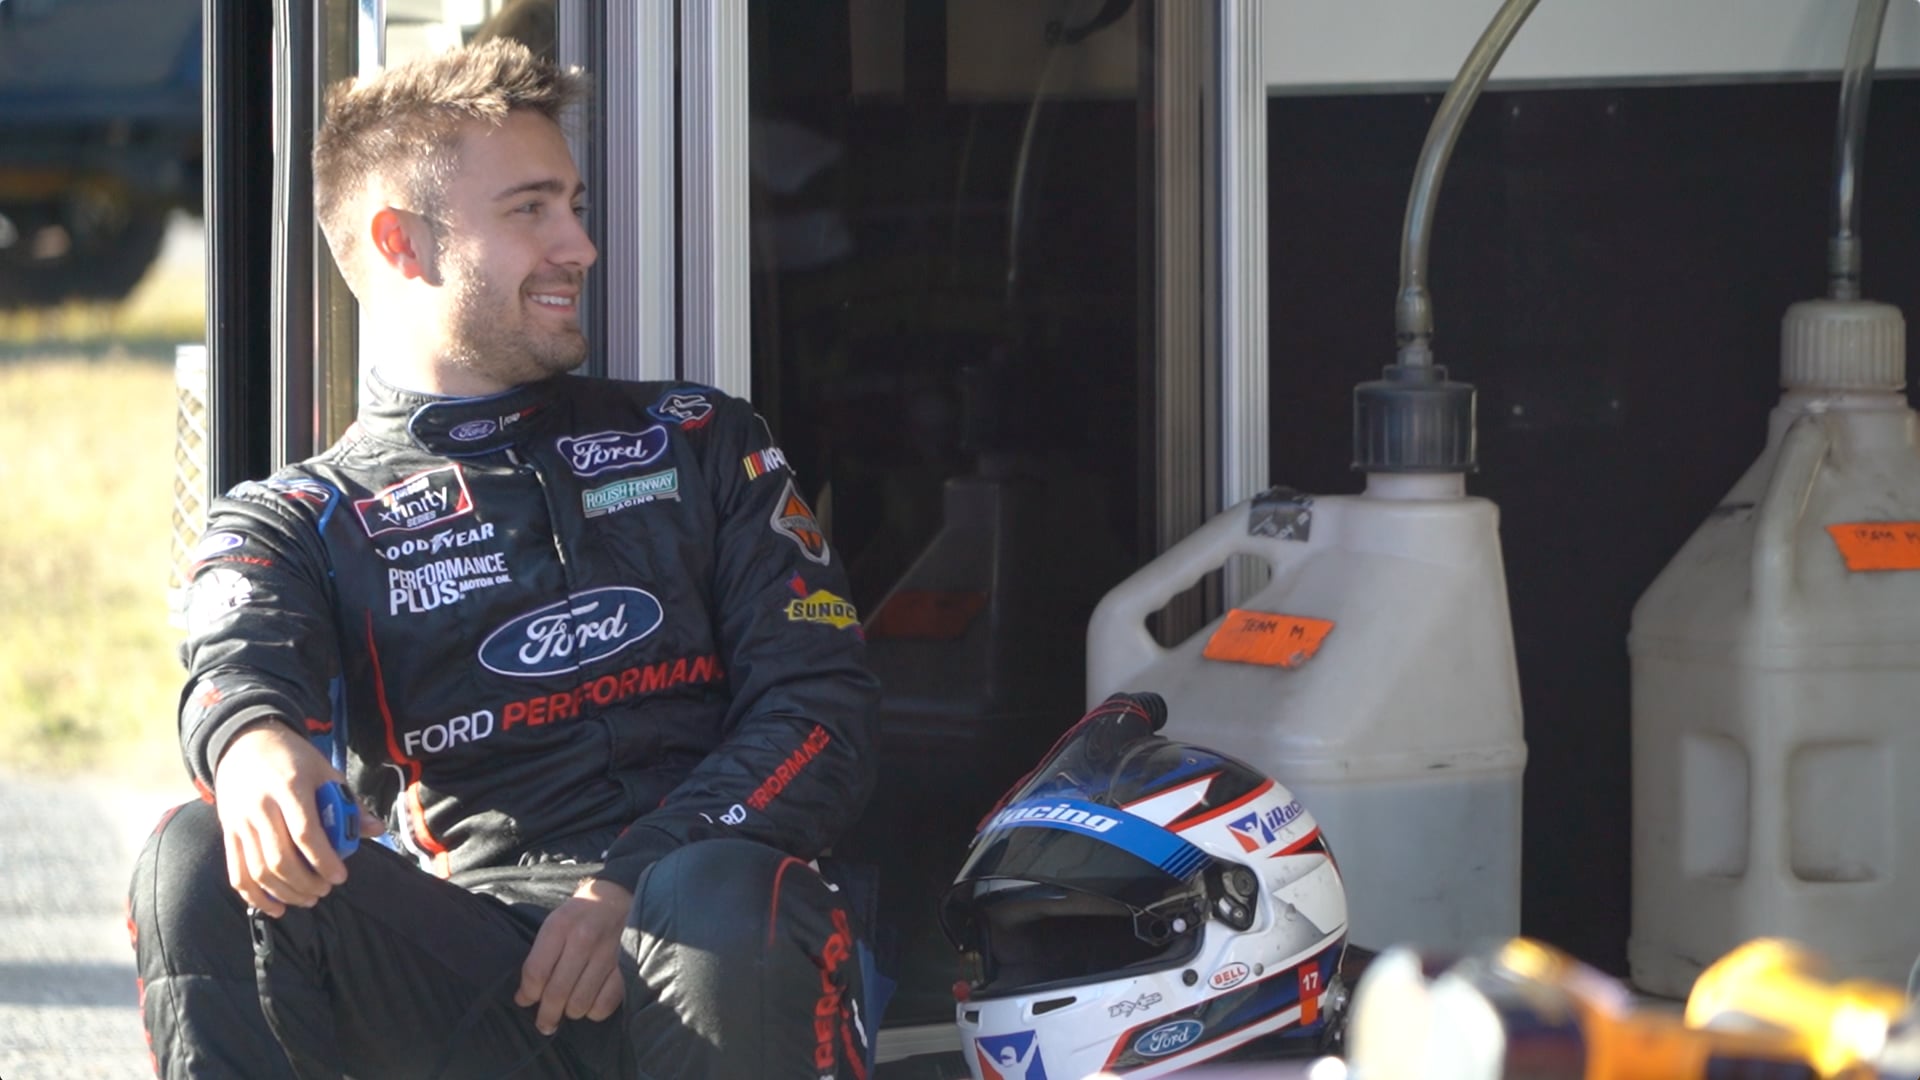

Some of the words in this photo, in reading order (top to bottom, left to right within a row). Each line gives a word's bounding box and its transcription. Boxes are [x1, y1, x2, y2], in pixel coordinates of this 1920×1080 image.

[458, 422, 490, 438] Ford
[573, 435, 648, 470] Ford
[378, 486, 448, 526] xfinity
[586, 481, 628, 509] ROUSH
[628, 472, 674, 497] FENWAY
[607, 494, 655, 514] RACING
[406, 510, 437, 528] SERIES
[380, 522, 495, 561] OODYEAR
[388, 552, 508, 590] PERFORMANCE
[390, 579, 460, 616] PLUS
[459, 576, 494, 592] MOTOR
[518, 601, 628, 665] Ford
[1241, 617, 1278, 634] TEAM
[1289, 625, 1305, 639] M
[403, 709, 494, 756] FORD
[502, 655, 724, 731] PERFORMAN
[1213, 967, 1246, 985] BELL
[1302, 971, 1320, 992] 17
[1150, 1026, 1189, 1052] Ford
